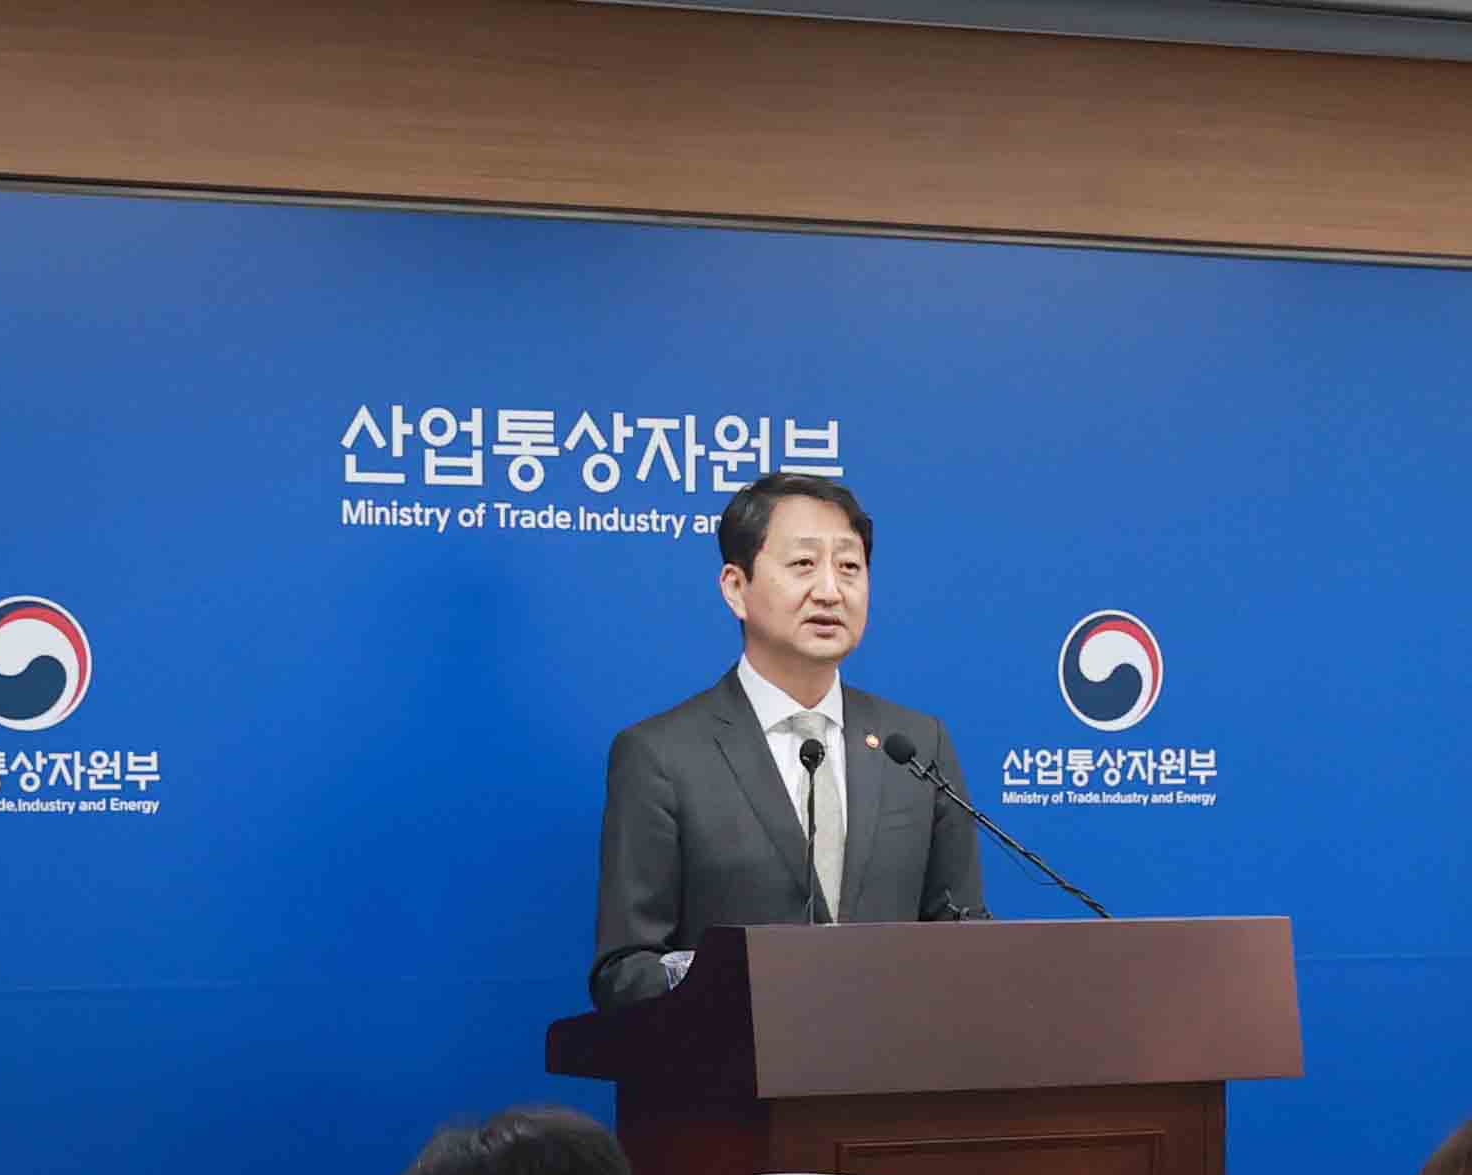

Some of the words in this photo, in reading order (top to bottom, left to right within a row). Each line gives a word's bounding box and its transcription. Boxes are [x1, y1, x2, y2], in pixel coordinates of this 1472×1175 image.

[342, 500, 450, 533] Ministry
[458, 502, 486, 528] of
[1003, 749, 1217, 786] 산업통상자원부
[79, 799, 106, 812] and
[110, 798, 160, 814] Energy
[1002, 791, 1048, 807] Ministry
[1151, 791, 1174, 804] and
[1177, 791, 1217, 807] Energy
